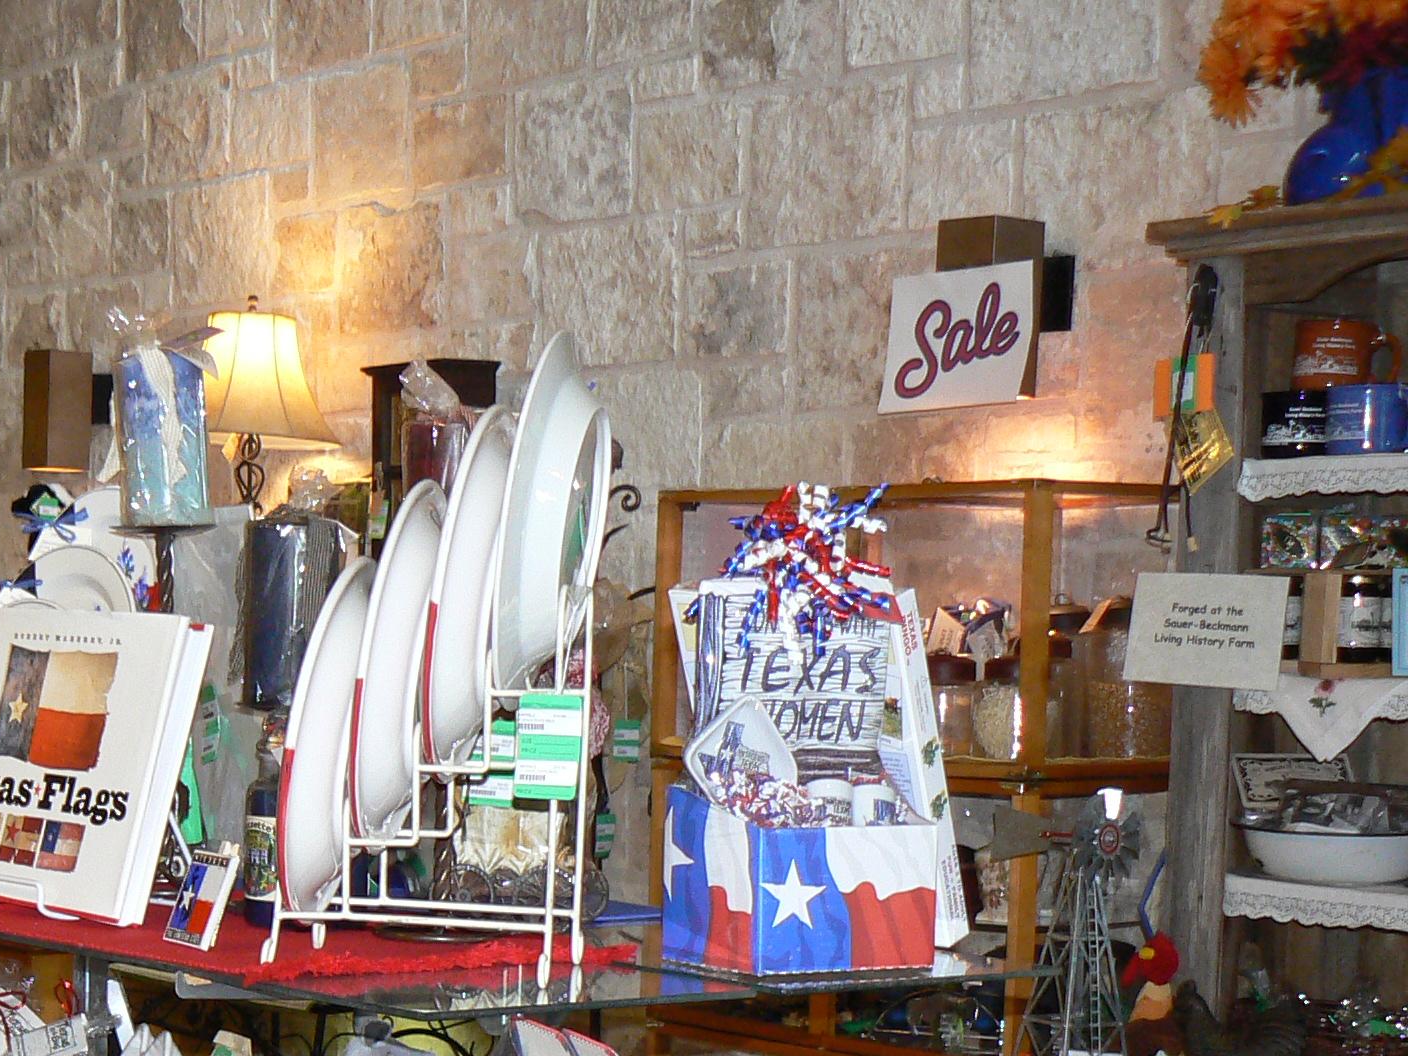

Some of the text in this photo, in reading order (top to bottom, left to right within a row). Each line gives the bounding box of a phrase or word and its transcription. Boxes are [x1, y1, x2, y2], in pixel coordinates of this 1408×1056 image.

[894, 281, 1020, 398] Sale
[1163, 618, 1250, 633] Sauer-Beckmann
[1171, 602, 1244, 616] Forged at the
[1154, 633, 1256, 649] Living History Farm
[738, 644, 882, 696] TEXAS
[766, 698, 867, 745] OMEN
[37, 773, 130, 826] Flags
